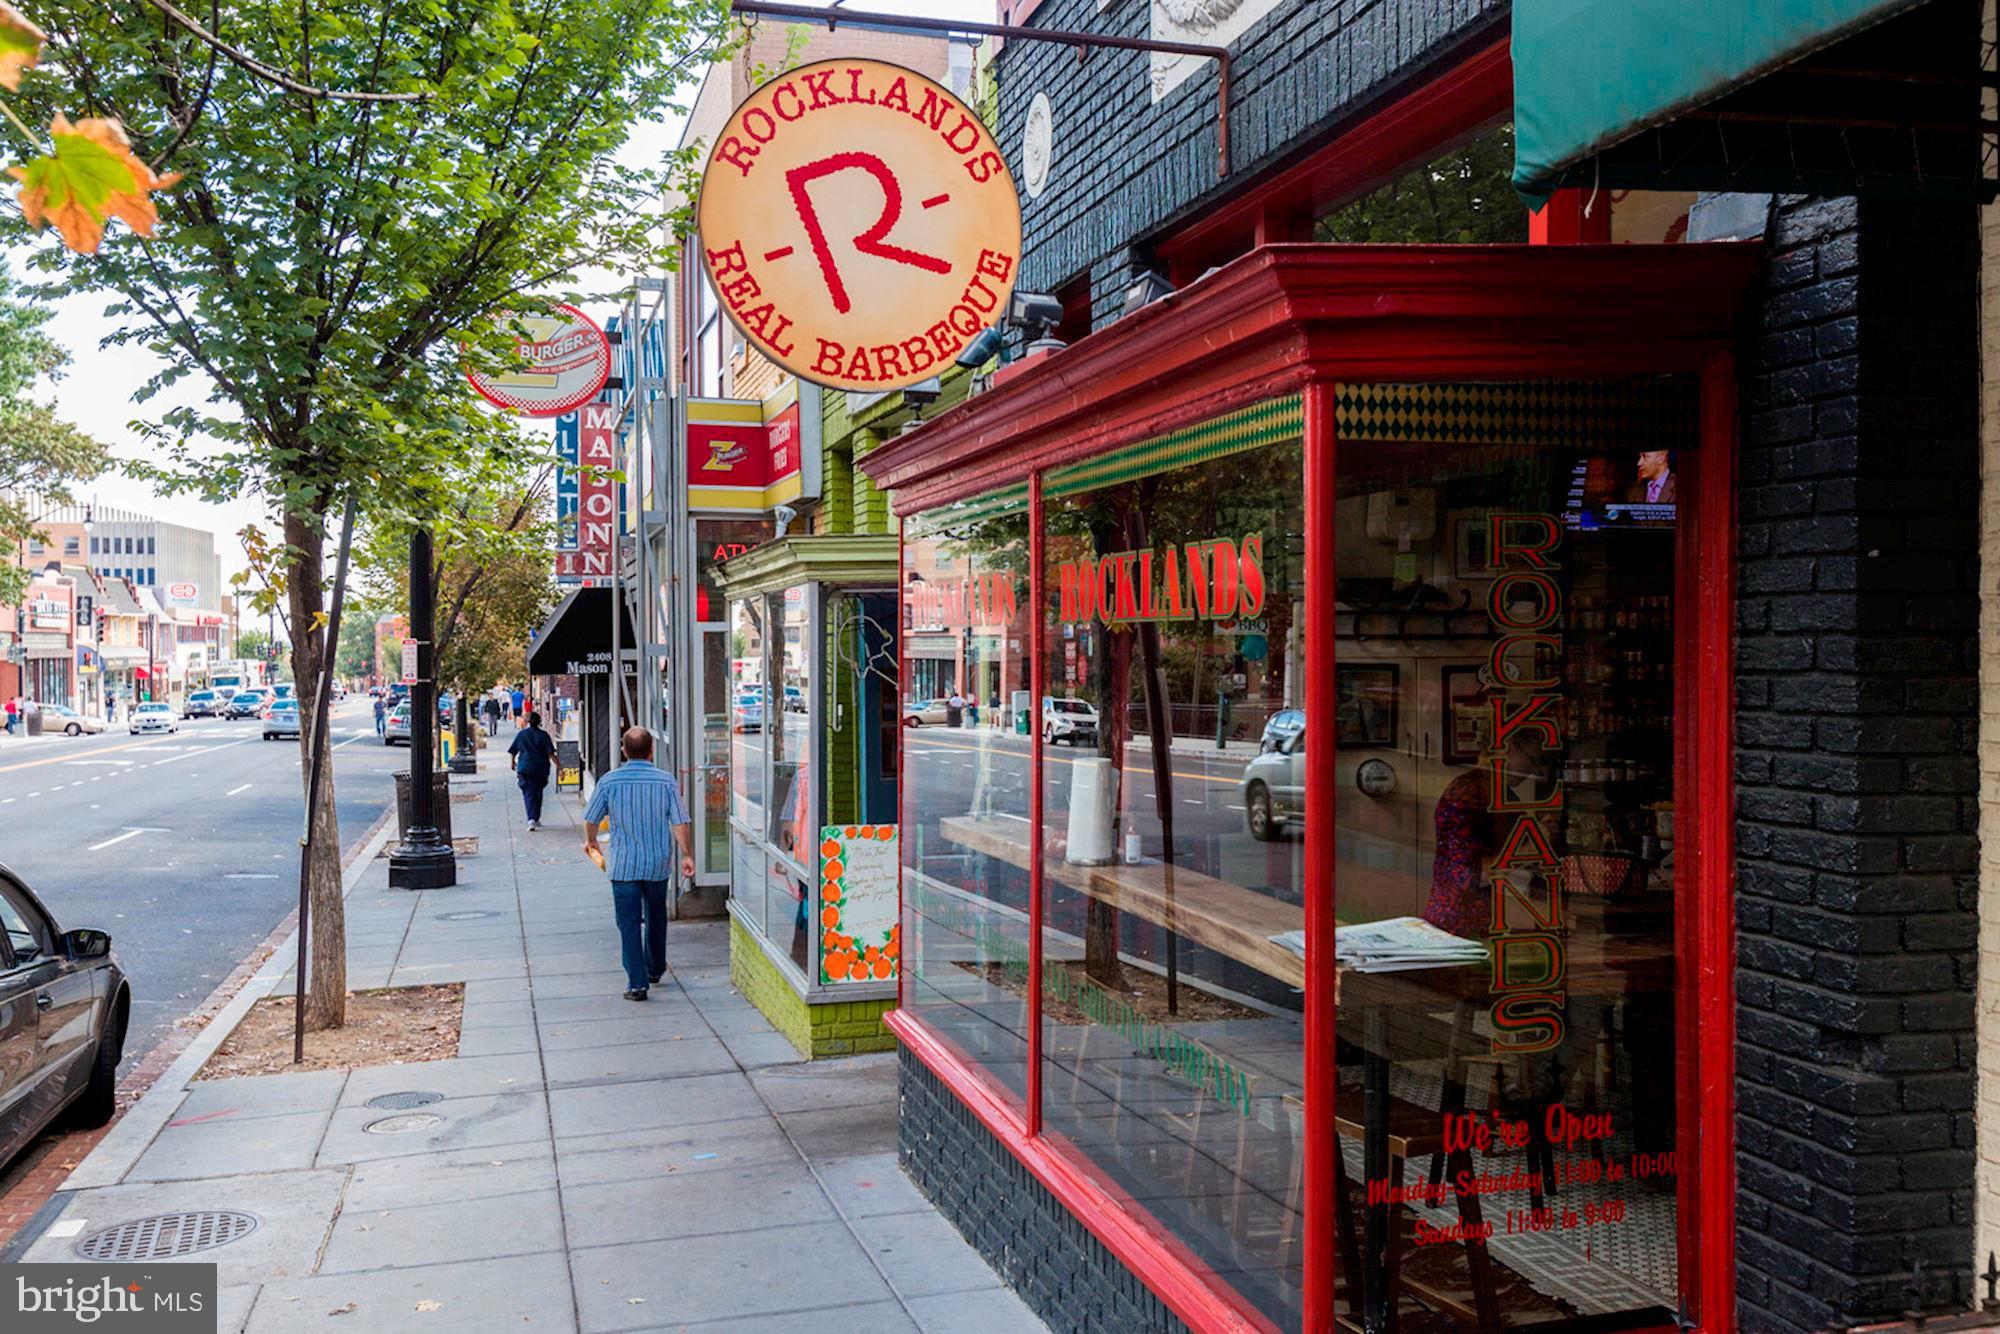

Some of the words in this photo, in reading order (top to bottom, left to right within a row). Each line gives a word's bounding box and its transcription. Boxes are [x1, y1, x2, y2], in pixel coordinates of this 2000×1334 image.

[715, 68, 1003, 183] ROCKLANDS
[706, 240, 794, 357] REAL
[810, 249, 1013, 381] BARBEQUE
[520, 333, 585, 360] BURGER
[584, 407, 613, 546] MASON
[1059, 531, 1265, 624] ROCKLANDS
[567, 661, 608, 674] Mason
[586, 652, 612, 662] 2408
[1487, 513, 1566, 1056] ROCKLANDS
[1442, 1109, 1531, 1154] We're
[1544, 1103, 1616, 1149] Open
[1367, 1165, 1542, 1208] Monday-Saturday
[1554, 1159, 1602, 1185] 11:00
[1606, 1157, 1625, 1182] to
[1631, 1151, 1677, 1178] 10:00
[1413, 1216, 1494, 1246] Sundays
[1506, 1207, 1555, 1235] 11:00
[1561, 1206, 1578, 1230] to
[1585, 1199, 1625, 1227] 9:00
